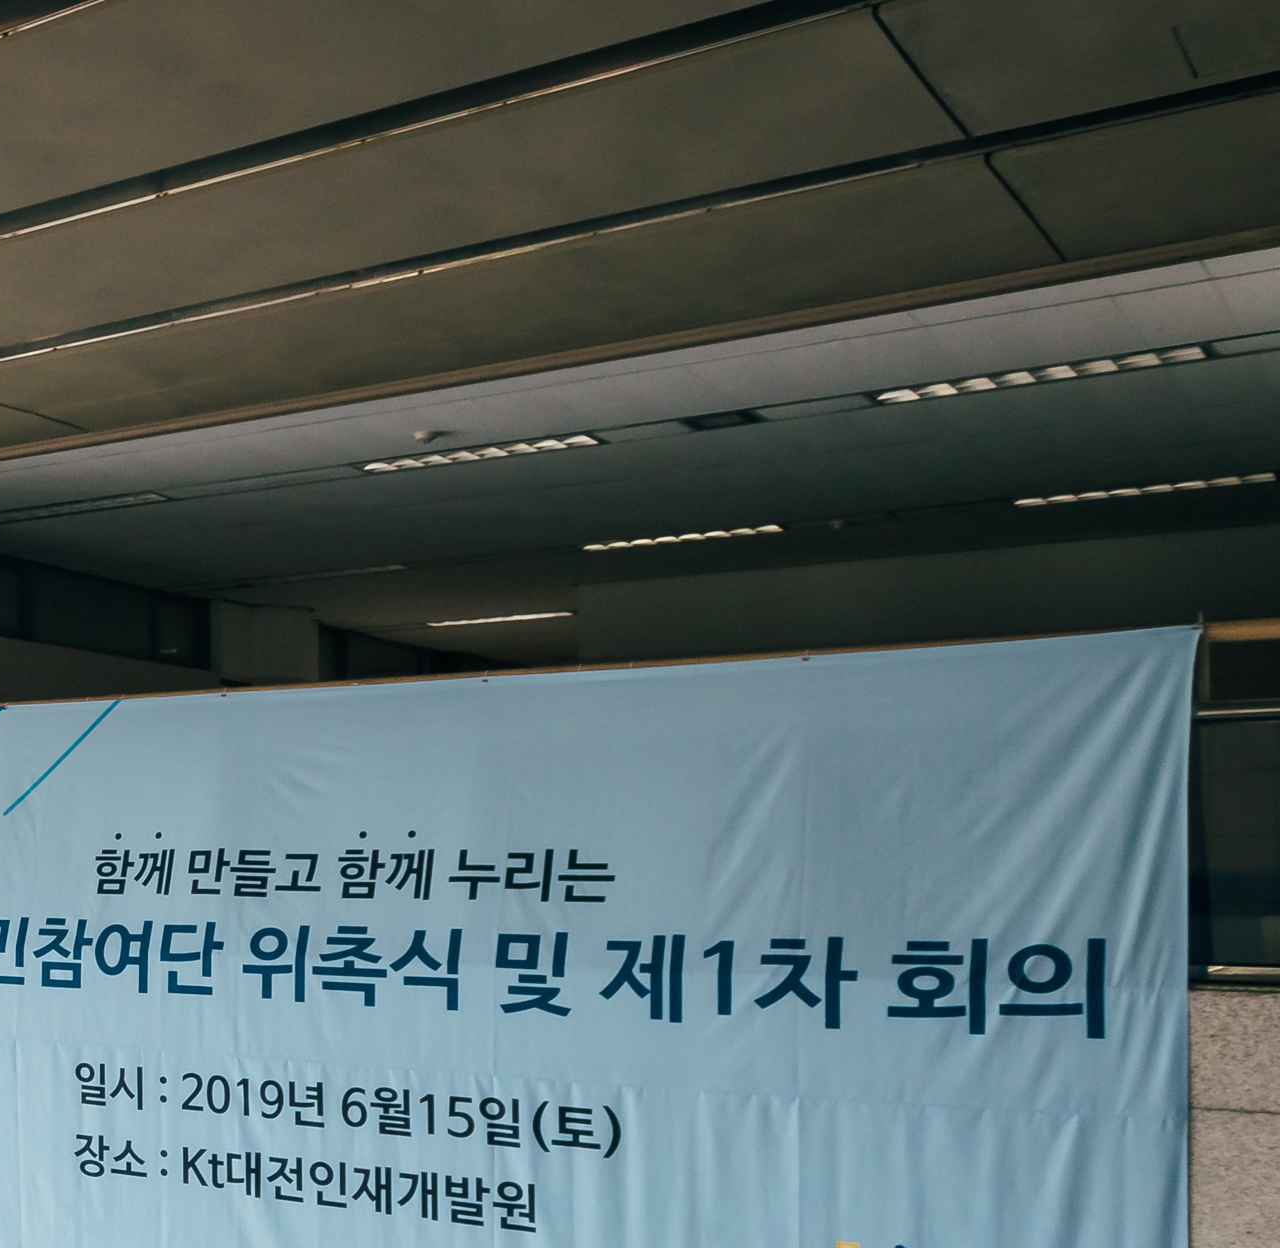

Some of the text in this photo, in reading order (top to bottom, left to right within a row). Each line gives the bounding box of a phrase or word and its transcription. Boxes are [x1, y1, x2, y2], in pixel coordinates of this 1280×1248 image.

[95, 848, 616, 903] 함께 만들고 함께 누리는
[243, 923, 462, 1011] 위촉식
[494, 931, 572, 1017] 및
[599, 933, 858, 1030] 제1차
[887, 937, 1107, 1039] 회의
[74, 1062, 145, 1111] 일시
[180, 1072, 326, 1128] 2019년
[341, 1086, 621, 1158] 6월15일(토)
[74, 1133, 147, 1178] 장소
[181, 1146, 537, 1233] Kt대전인재개발원
